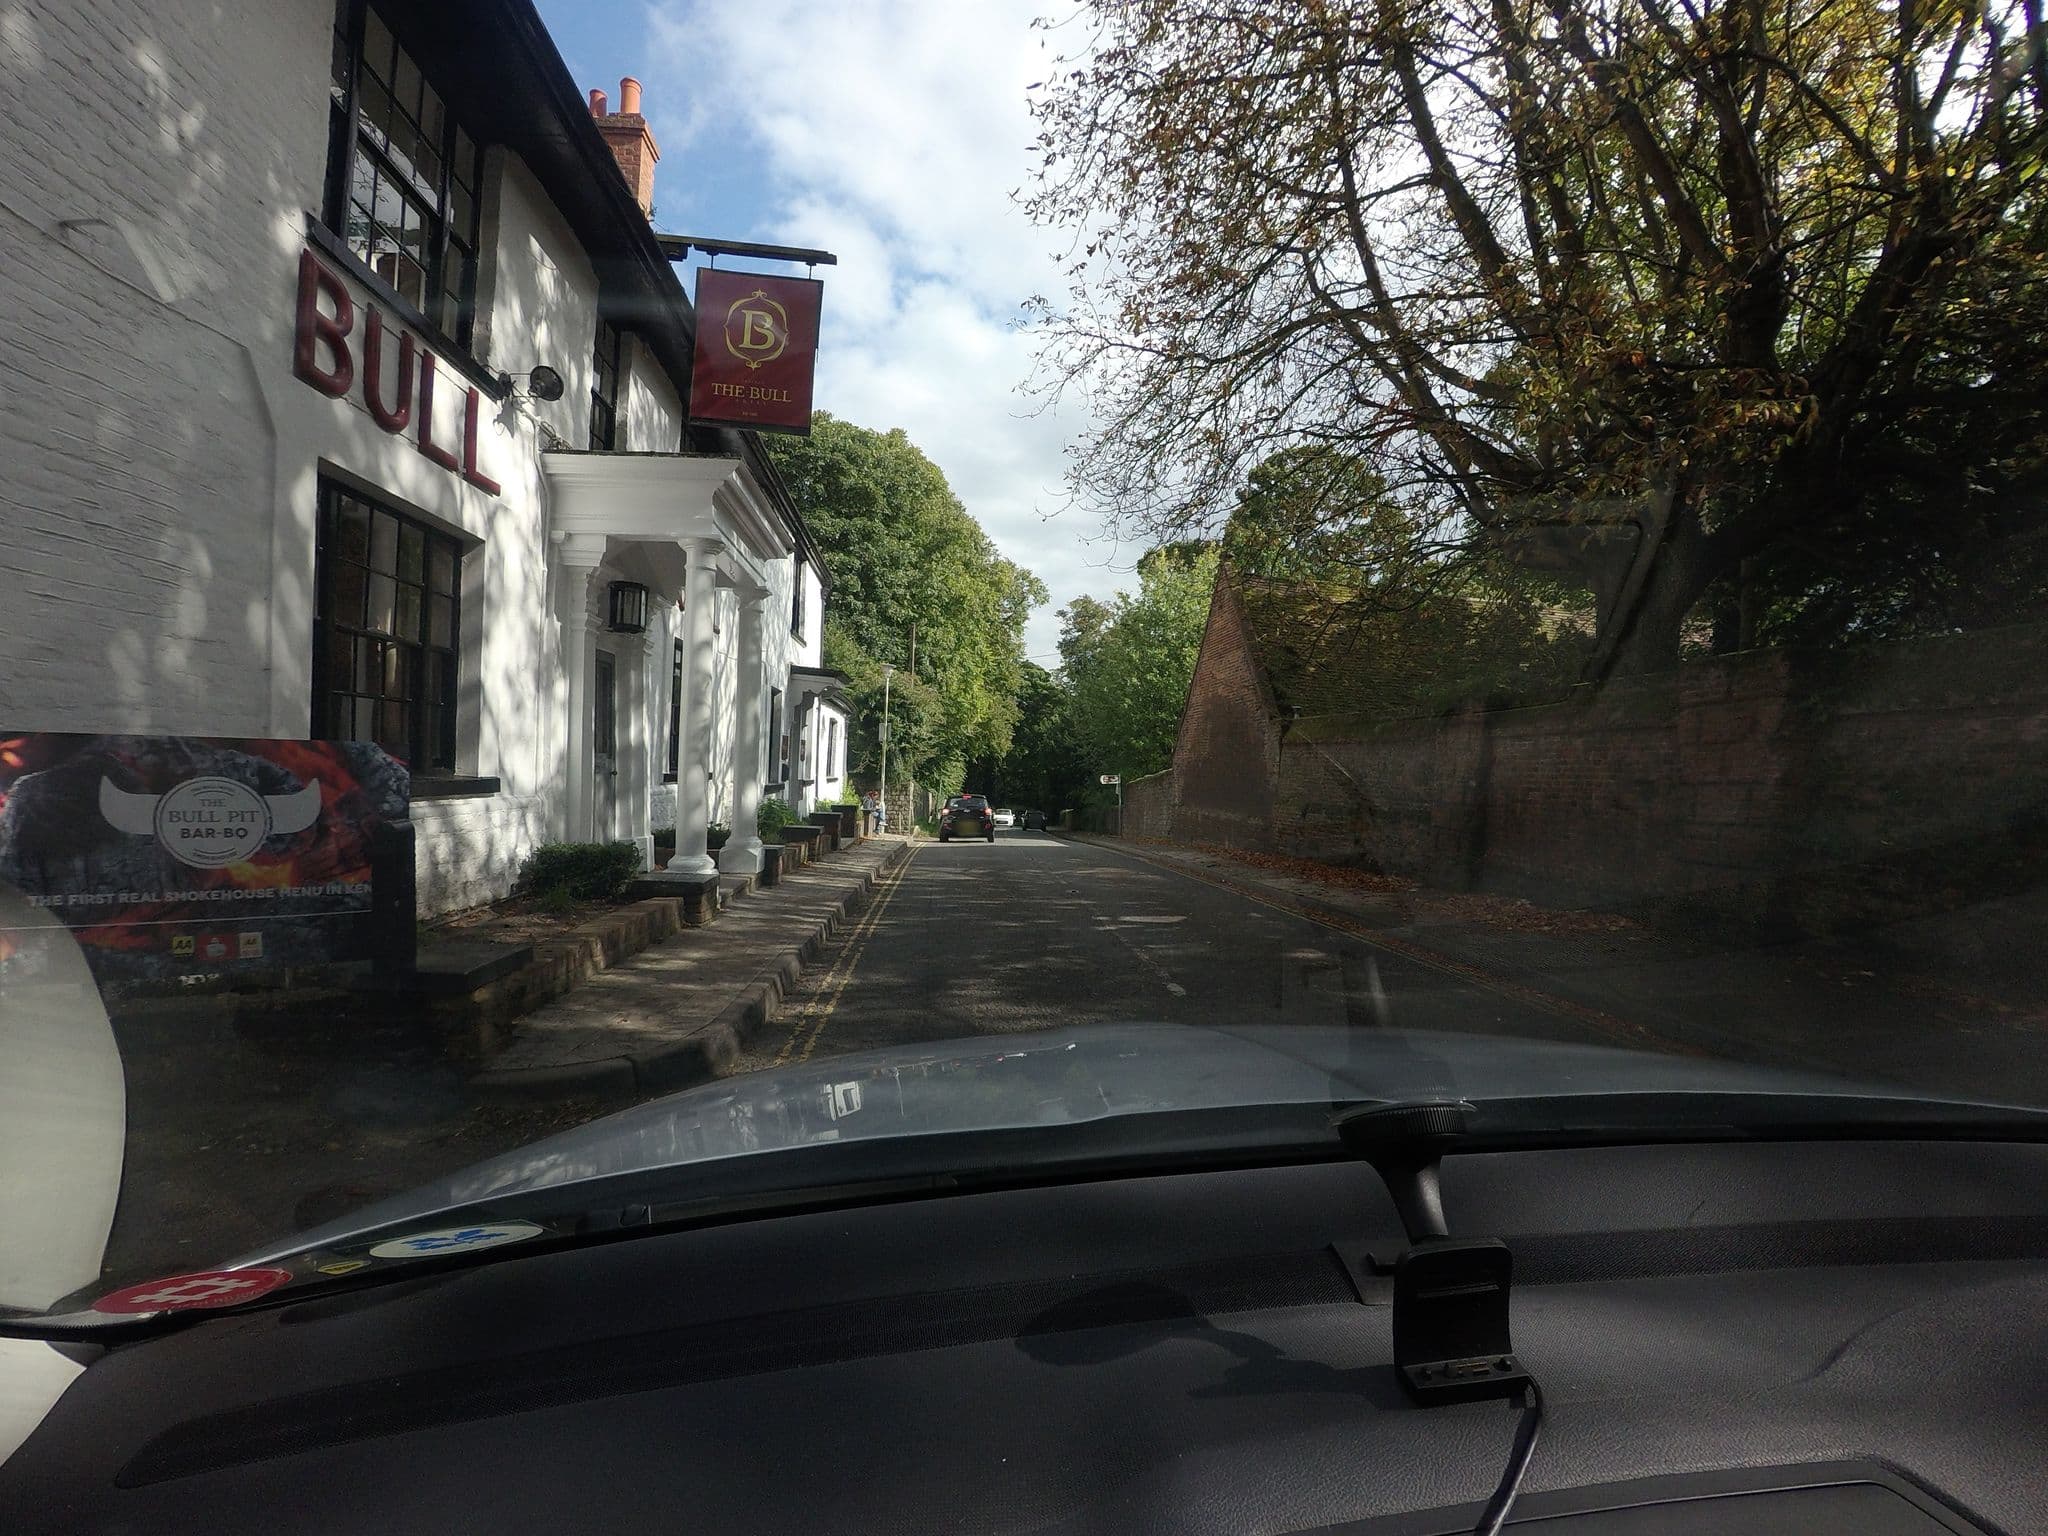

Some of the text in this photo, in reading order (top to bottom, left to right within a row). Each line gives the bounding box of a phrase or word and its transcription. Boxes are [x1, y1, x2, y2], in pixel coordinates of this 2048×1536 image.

[294, 248, 501, 496] BULL
[711, 382, 746, 398] THE
[749, 386, 793, 403] BULL
[199, 798, 226, 808] THE
[168, 810, 259, 823] BULL PIT
[180, 827, 248, 840] BAR-BQ
[28, 894, 64, 907] THE
[68, 893, 114, 906] FIRST
[118, 892, 161, 904] REAL
[162, 887, 275, 903] SMOKEHOUSE
[279, 886, 322, 898] MENU
